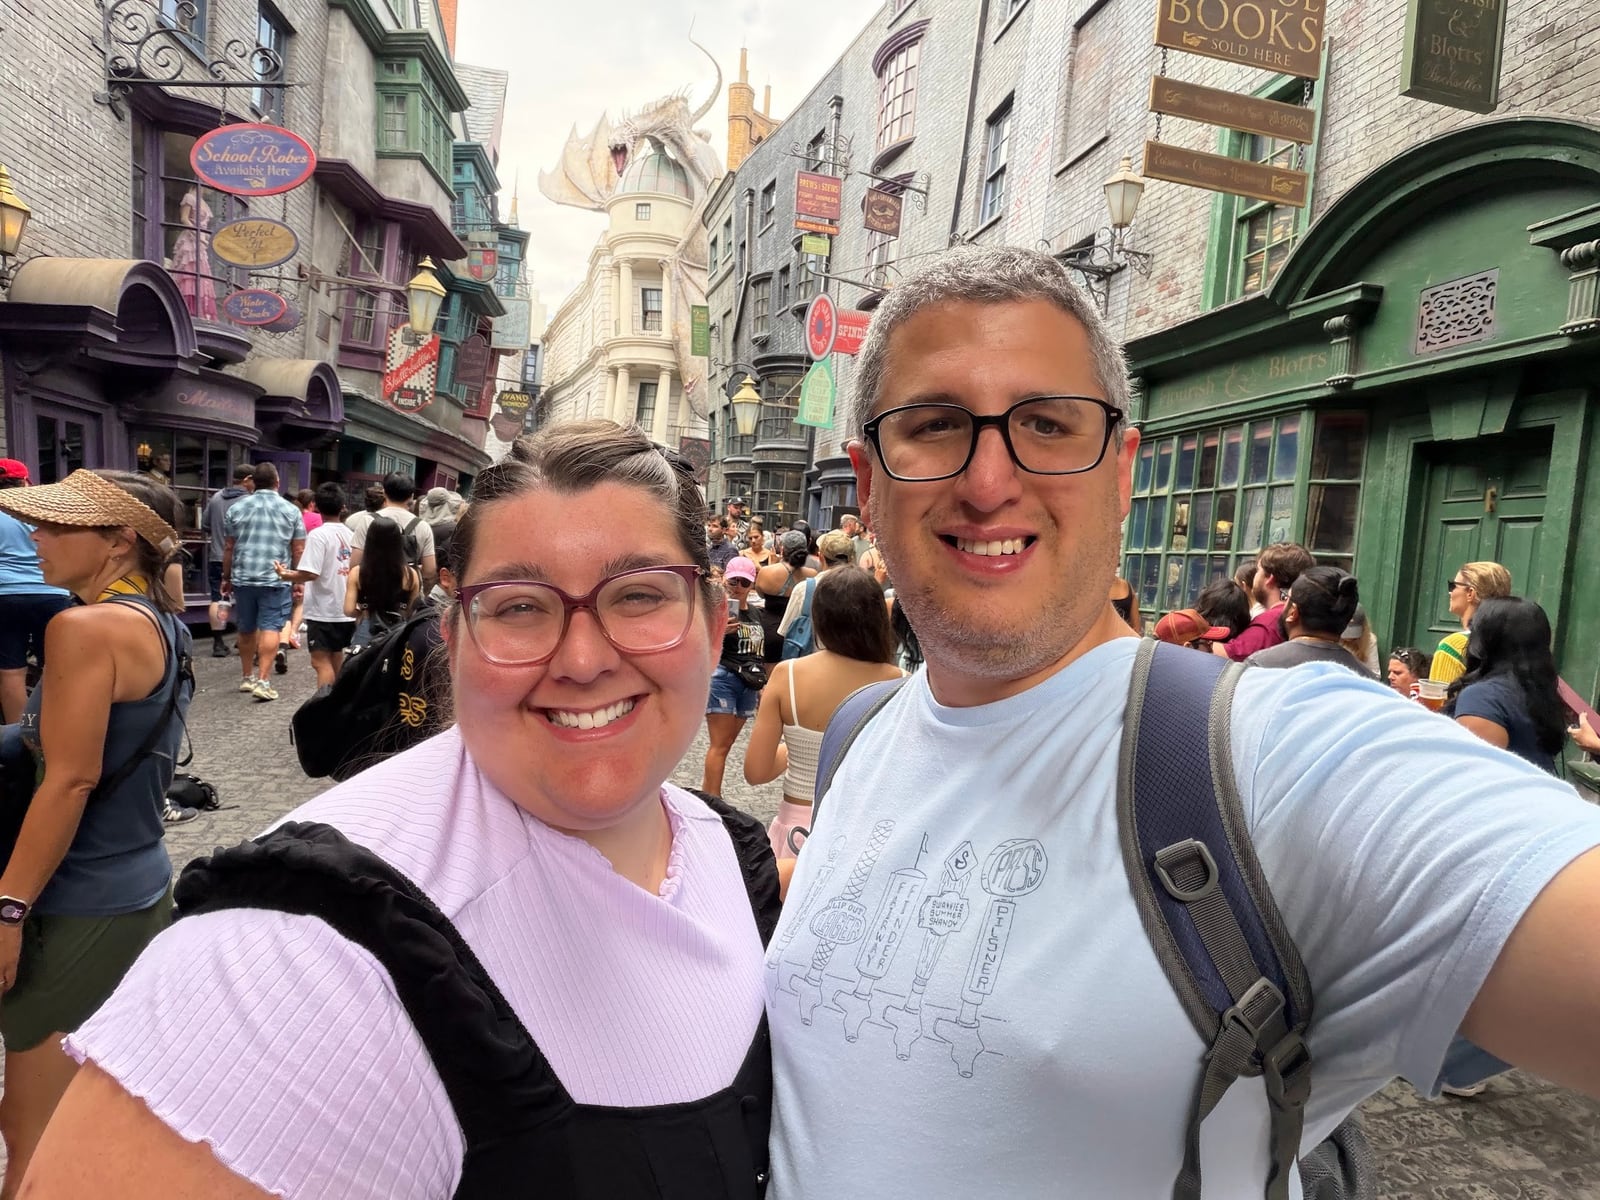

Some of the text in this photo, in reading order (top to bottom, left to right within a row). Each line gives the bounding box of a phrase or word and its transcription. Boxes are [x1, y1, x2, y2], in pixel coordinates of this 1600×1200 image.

[1168, 0, 1318, 53] BOOKS
[1211, 39, 1292, 67] SOLD HERE
[1431, 33, 1483, 65] Blotts
[198, 143, 308, 164] School Robes
[215, 164, 290, 177] Available Here
[233, 223, 275, 238] Perfect
[240, 295, 267, 307] Winter
[1268, 351, 1328, 380] Blotts
[502, 393, 529, 402] WAND
[954, 850, 969, 870] S
[848, 904, 863, 915] OUT
[929, 909, 963, 920] SUMMER
[816, 911, 863, 942] LAGER
[928, 917, 959, 928] SHANDY
[976, 905, 1009, 990] PILSNER
